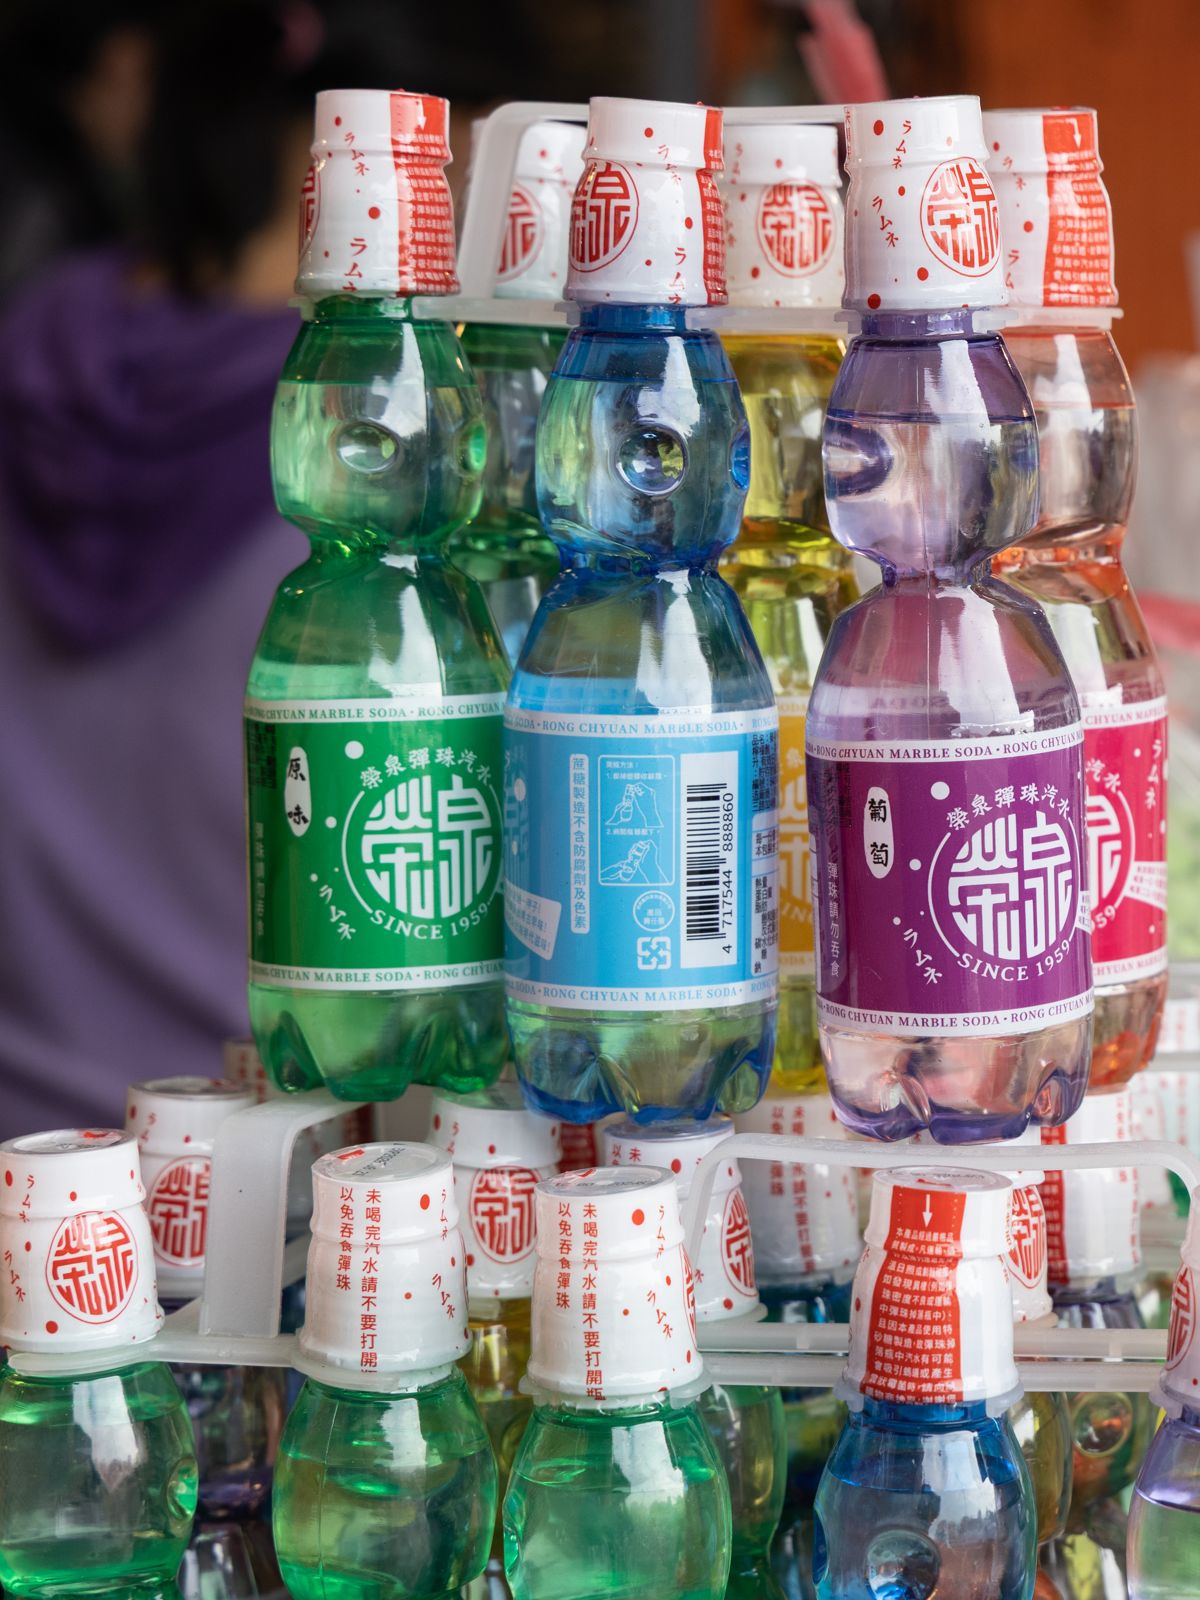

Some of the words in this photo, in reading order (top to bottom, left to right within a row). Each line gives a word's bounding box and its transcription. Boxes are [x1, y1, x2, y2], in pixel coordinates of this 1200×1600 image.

[872, 195, 899, 247] ラムネ
[309, 707, 365, 720] MARBLE
[369, 706, 408, 719] SODA
[418, 704, 455, 718] RONG
[458, 702, 500, 716] CHYUAN
[542, 720, 576, 734] RONG
[579, 722, 639, 735] CHYUAN
[644, 722, 703, 735] MARBLE
[706, 720, 738, 734] SODA
[838, 746, 884, 760] CHYUAN
[890, 747, 950, 760] MARBLE
[954, 745, 992, 759] SODA
[1003, 739, 1039, 755] RONG
[1041, 732, 1078, 750] CHYUAN
[287, 757, 309, 826] 原味
[947, 784, 1070, 831] 榮泉彈珠汽水
[722, 792, 734, 853] 888860
[868, 798, 890, 868] 葡萄
[319, 884, 356, 940] ラムネ
[370, 908, 444, 940] SINCE
[451, 901, 489, 937] 1959
[721, 869, 733, 930] 717544
[722, 944, 733, 954] 4
[903, 928, 943, 985] ラムネ
[957, 951, 1029, 983] SINCE
[1036, 939, 1071, 978] 1959
[314, 971, 371, 983] MARBLE
[375, 970, 413, 983] SODA
[424, 968, 460, 981] RONG
[543, 986, 577, 999] RONG
[580, 989, 639, 1002] CHYUAN
[644, 989, 703, 1002] MARBLE
[706, 986, 737, 999] SODA
[848, 1009, 893, 1026] CHYUAN
[898, 1014, 958, 1029] MARBLE
[962, 1014, 999, 1028] SODA
[1011, 1009, 1046, 1023] RONG
[1048, 1000, 1086, 1019] CHYUAN
[336, 1187, 355, 1291] 以免吞食彈珠
[556, 1202, 572, 1310] 以免吞食彈珠
[360, 1188, 382, 1373] 未喝完汽水請不要打開
[647, 1290, 673, 1339] ラムネ
